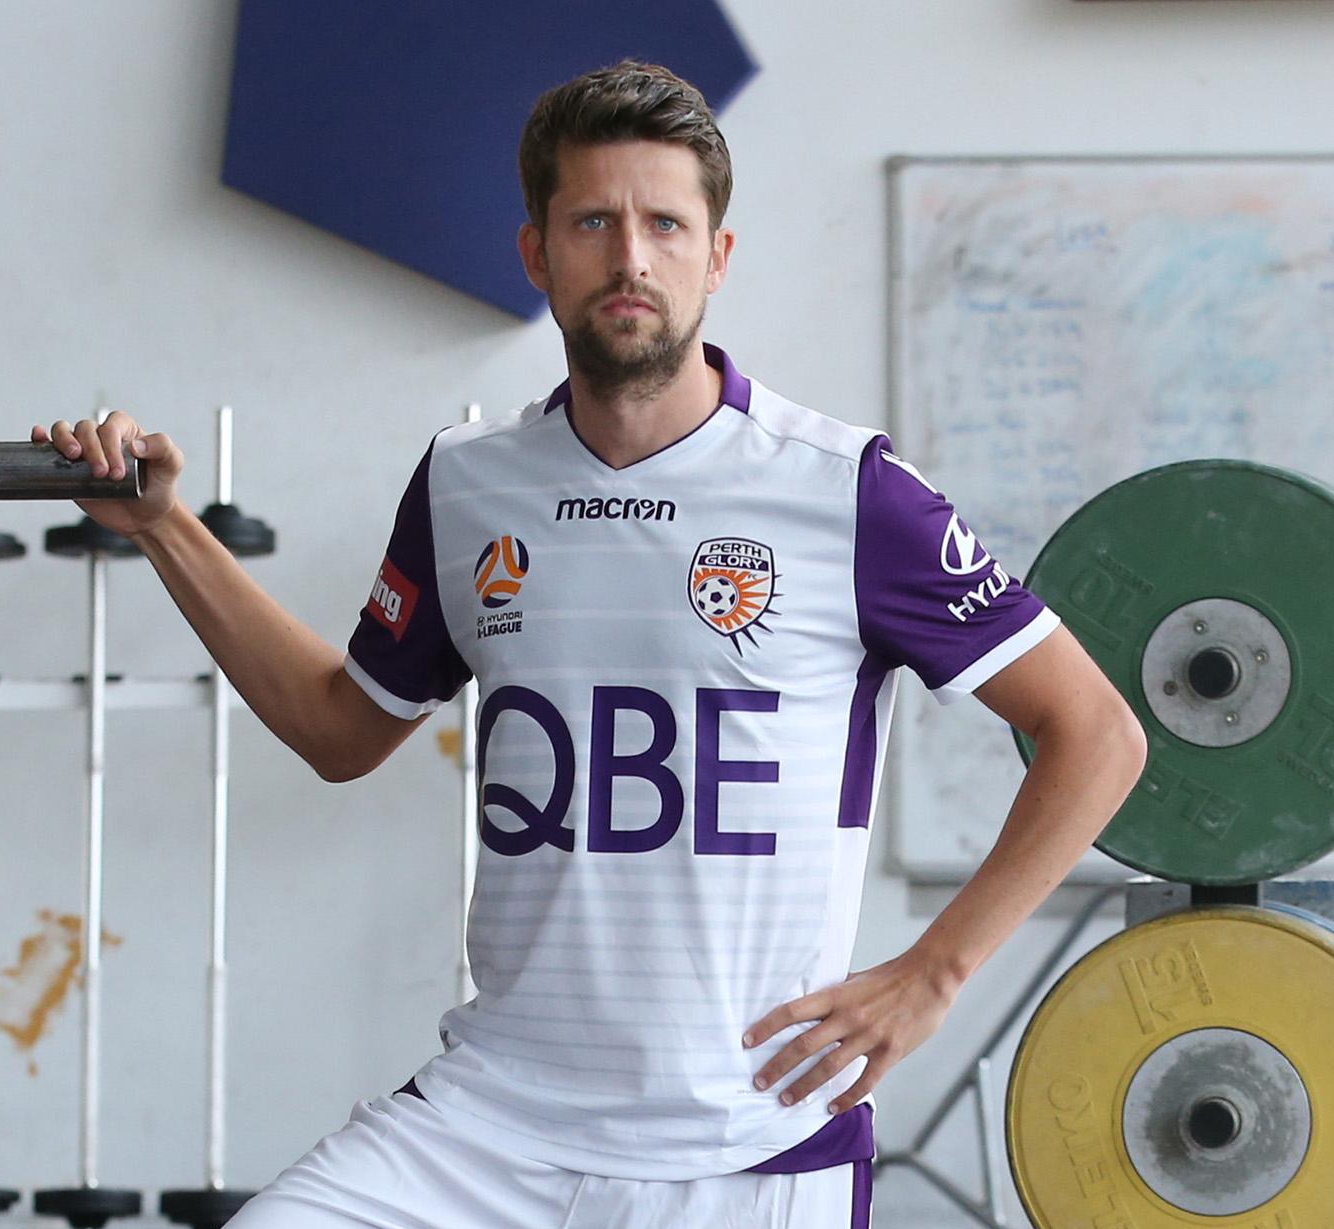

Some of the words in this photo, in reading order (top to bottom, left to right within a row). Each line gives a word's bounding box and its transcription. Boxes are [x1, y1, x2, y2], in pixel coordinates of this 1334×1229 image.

[556, 497, 677, 522] macron
[709, 543, 762, 558] PERTH
[705, 555, 763, 570] GLORY
[477, 685, 781, 857] QBE
